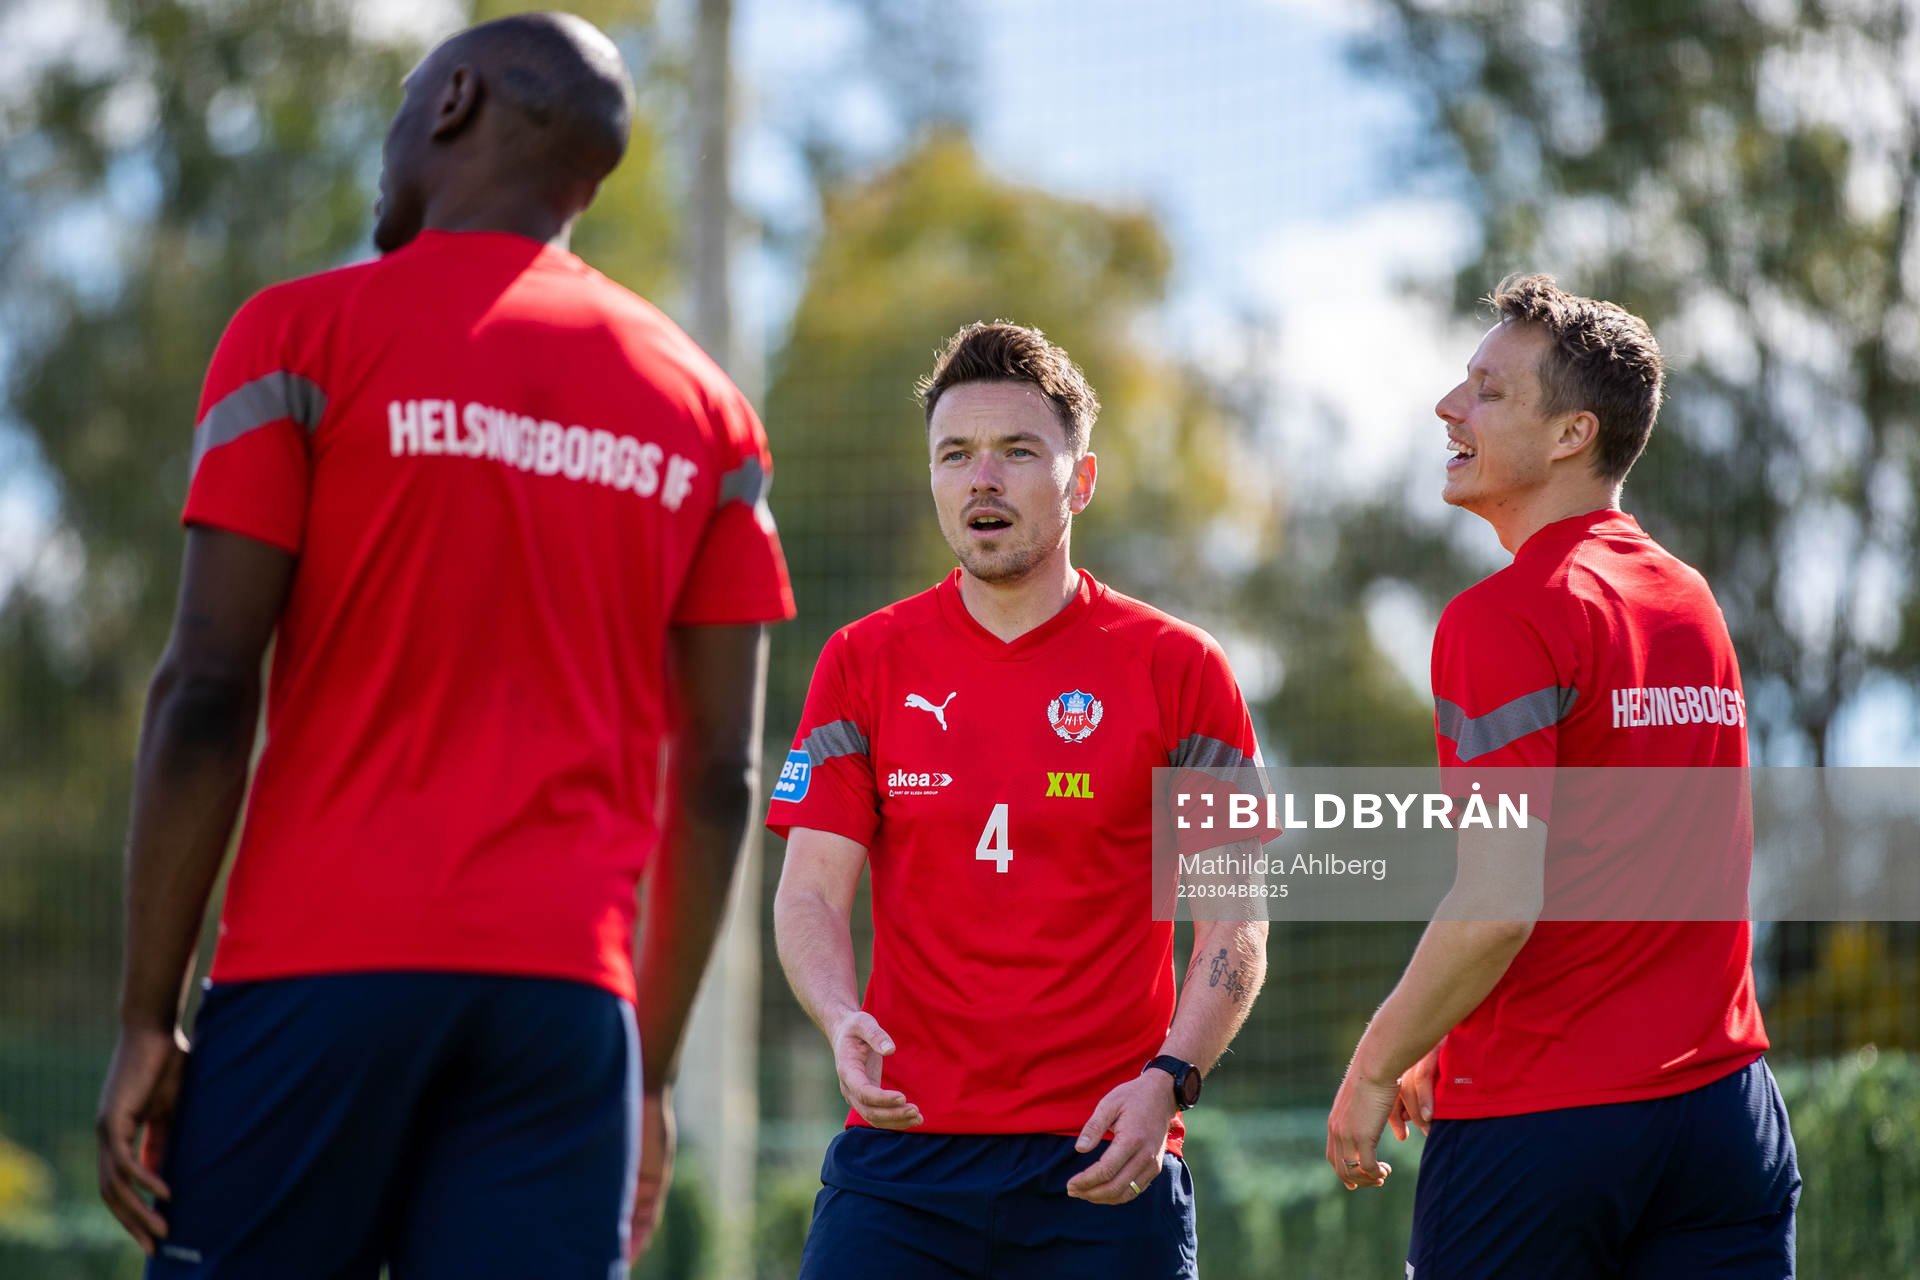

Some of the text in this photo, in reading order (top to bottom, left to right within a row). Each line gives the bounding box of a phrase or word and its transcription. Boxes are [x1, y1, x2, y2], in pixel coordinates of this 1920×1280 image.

[388, 399, 698, 513] HELSINGBORGS IF
[1611, 685, 1745, 728] HELSINGBOG
[888, 769, 930, 787] akea
[1046, 772, 1094, 799] XXL
[975, 803, 1013, 873] 4
